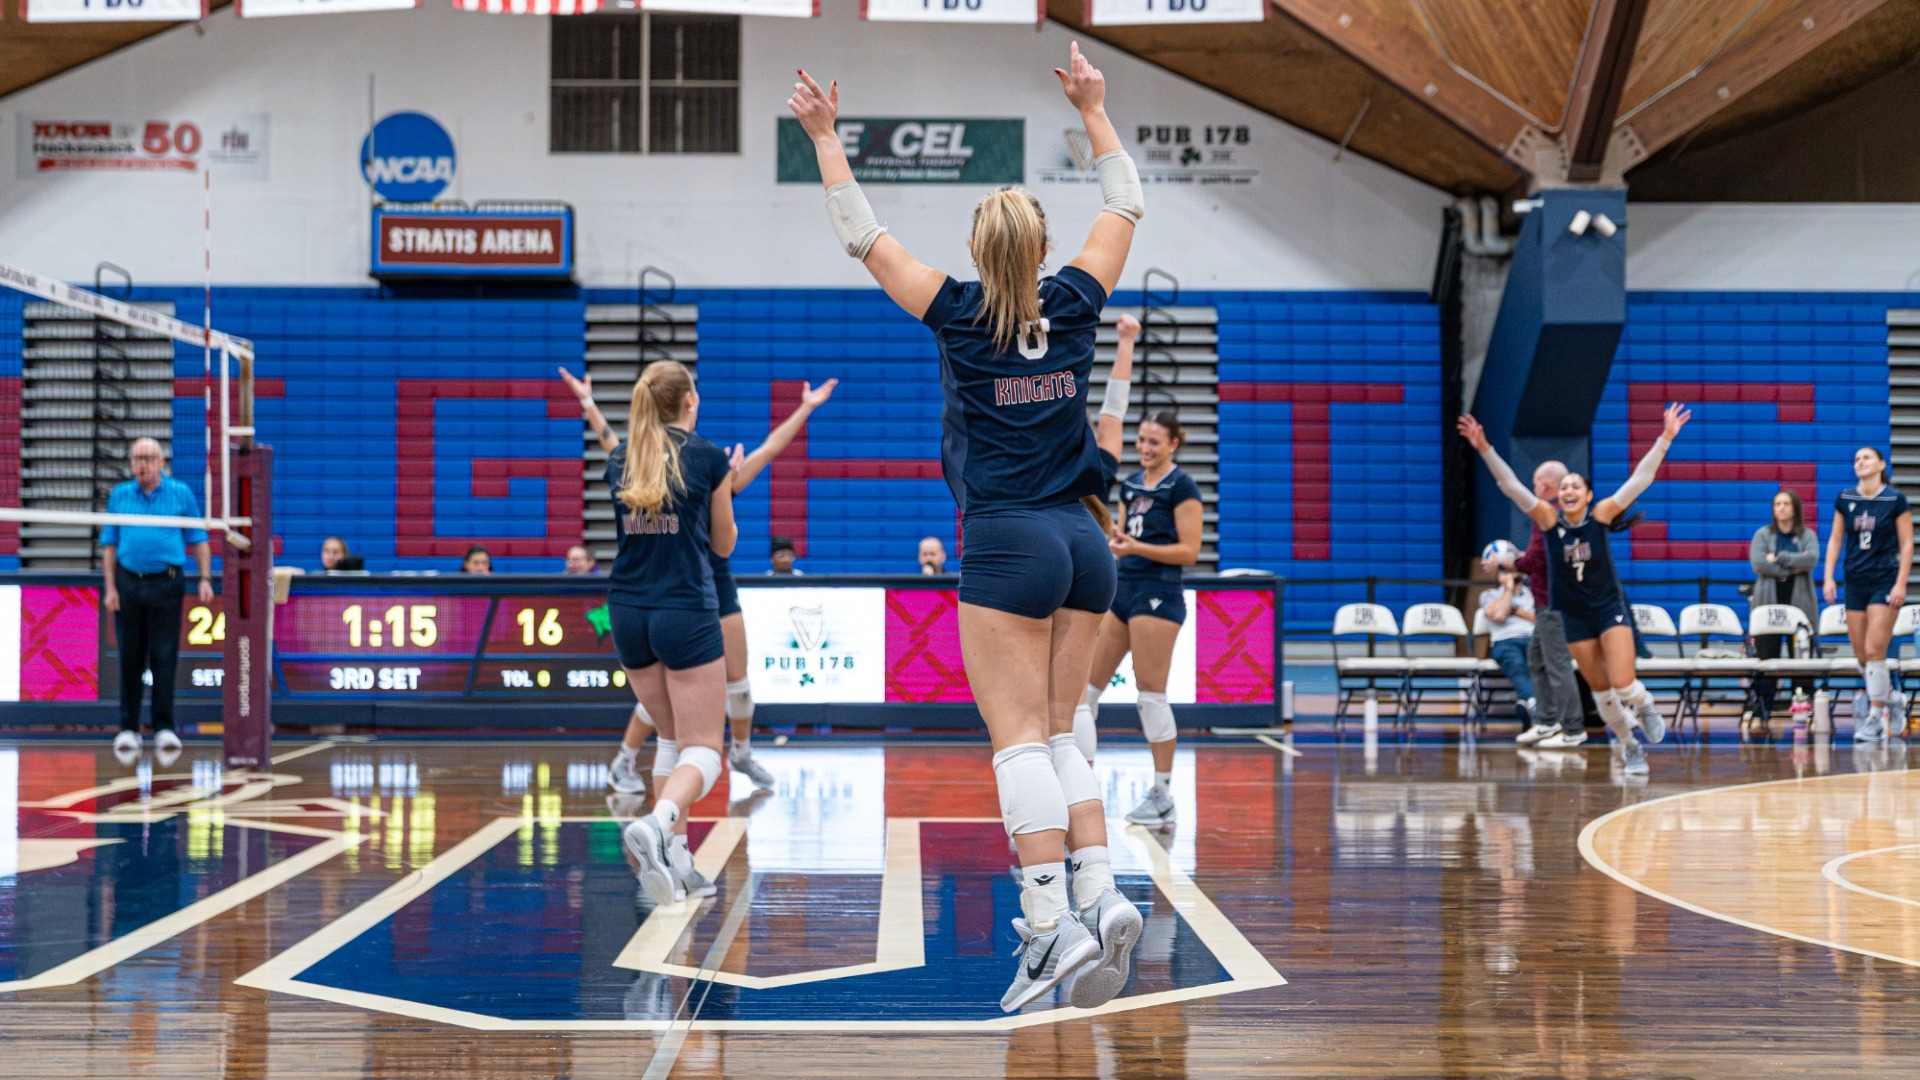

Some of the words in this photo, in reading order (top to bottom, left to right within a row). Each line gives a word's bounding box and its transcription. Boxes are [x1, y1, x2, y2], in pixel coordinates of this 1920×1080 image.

[143, 121, 201, 154] 50
[836, 121, 974, 163] EXCEL
[1137, 126, 1192, 144] PUB
[1204, 126, 1250, 144] 178
[367, 156, 453, 184] NCAA
[389, 226, 477, 254] STRATIS
[480, 228, 554, 254] ARENA
[994, 370, 1077, 407] KNIGHTS
[1572, 561, 1585, 582] 7
[342, 604, 438, 647] 1:15
[516, 607, 564, 646] 16
[765, 657, 806, 670] PUB
[819, 656, 855, 670] 178
[191, 668, 225, 687] SET
[329, 667, 375, 690] 3RD
[377, 667, 421, 690] SET
[501, 670, 533, 688] TOL
[567, 670, 609, 688] SETS
